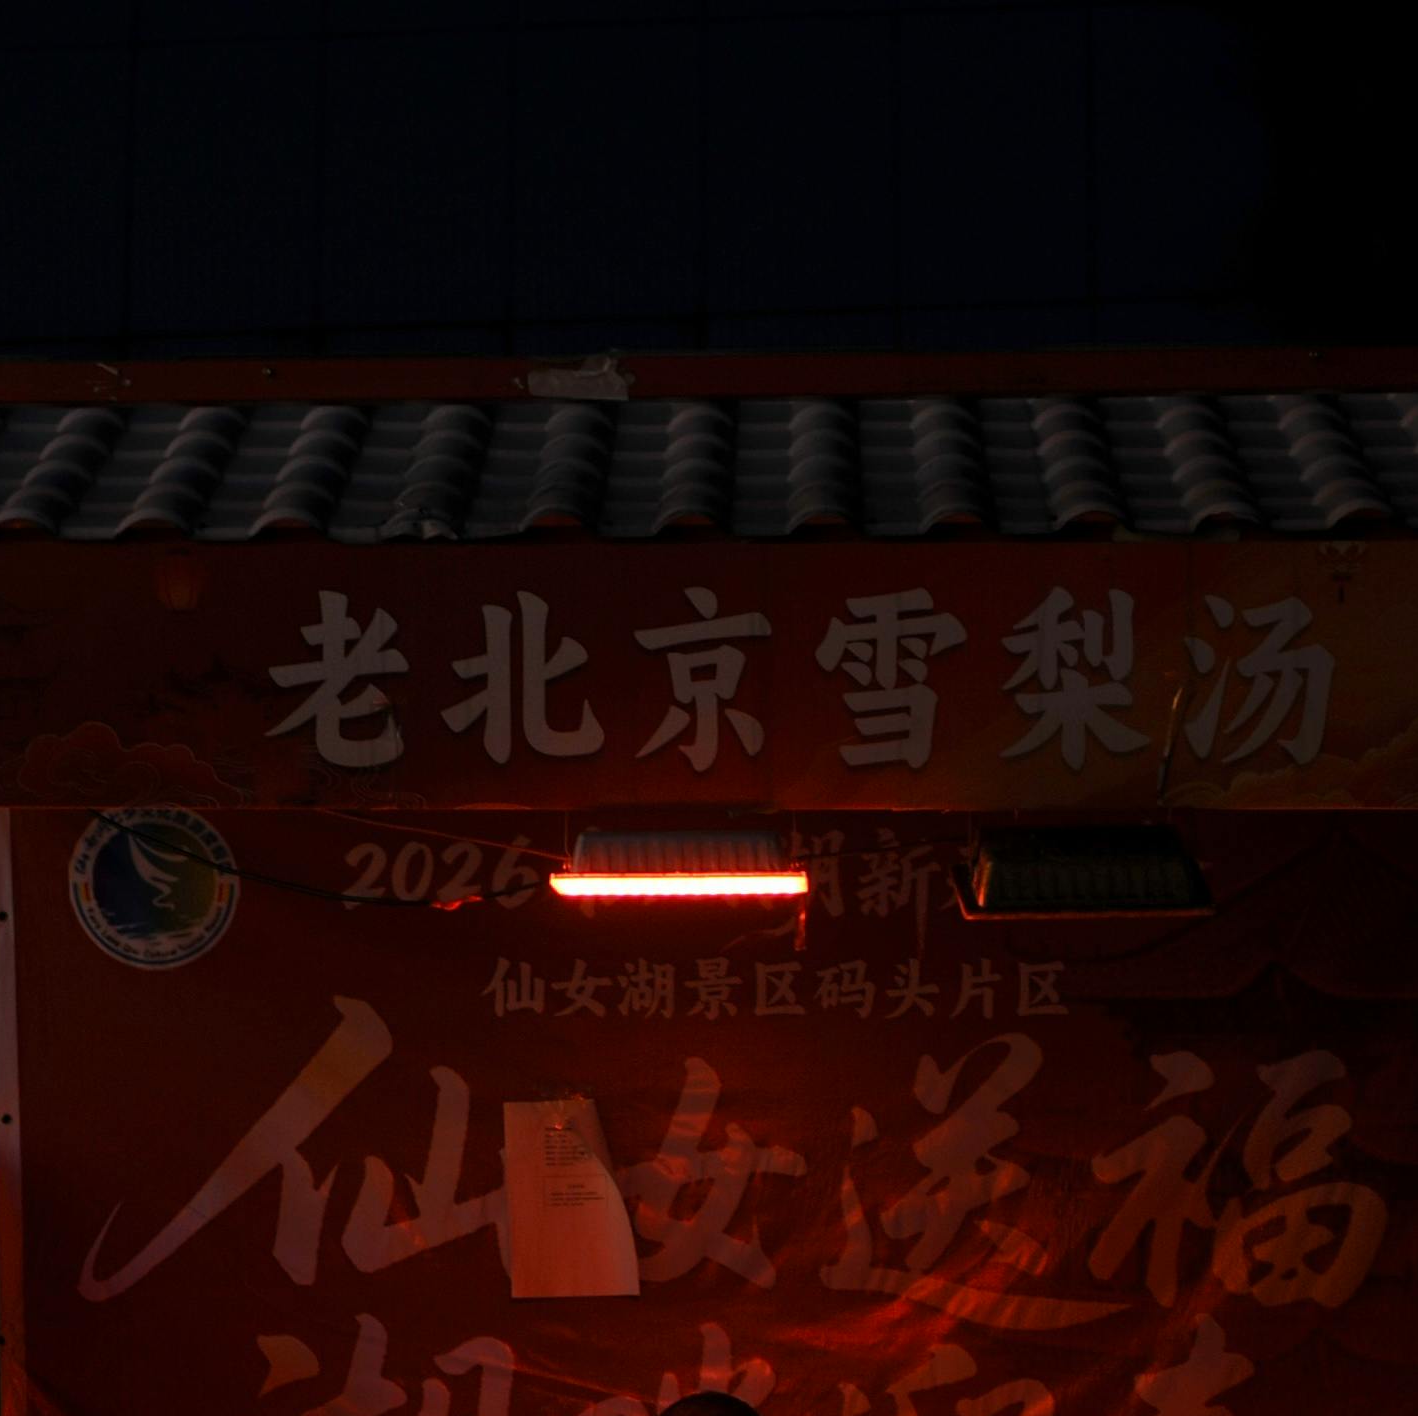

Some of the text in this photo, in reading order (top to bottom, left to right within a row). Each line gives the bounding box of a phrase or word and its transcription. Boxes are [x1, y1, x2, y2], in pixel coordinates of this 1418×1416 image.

[265, 586, 1336, 771] 老北京雪梨汤
[481, 956, 1069, 1021] 仙女湖景区码头片区
[78, 996, 1387, 1329] 仙女送福
